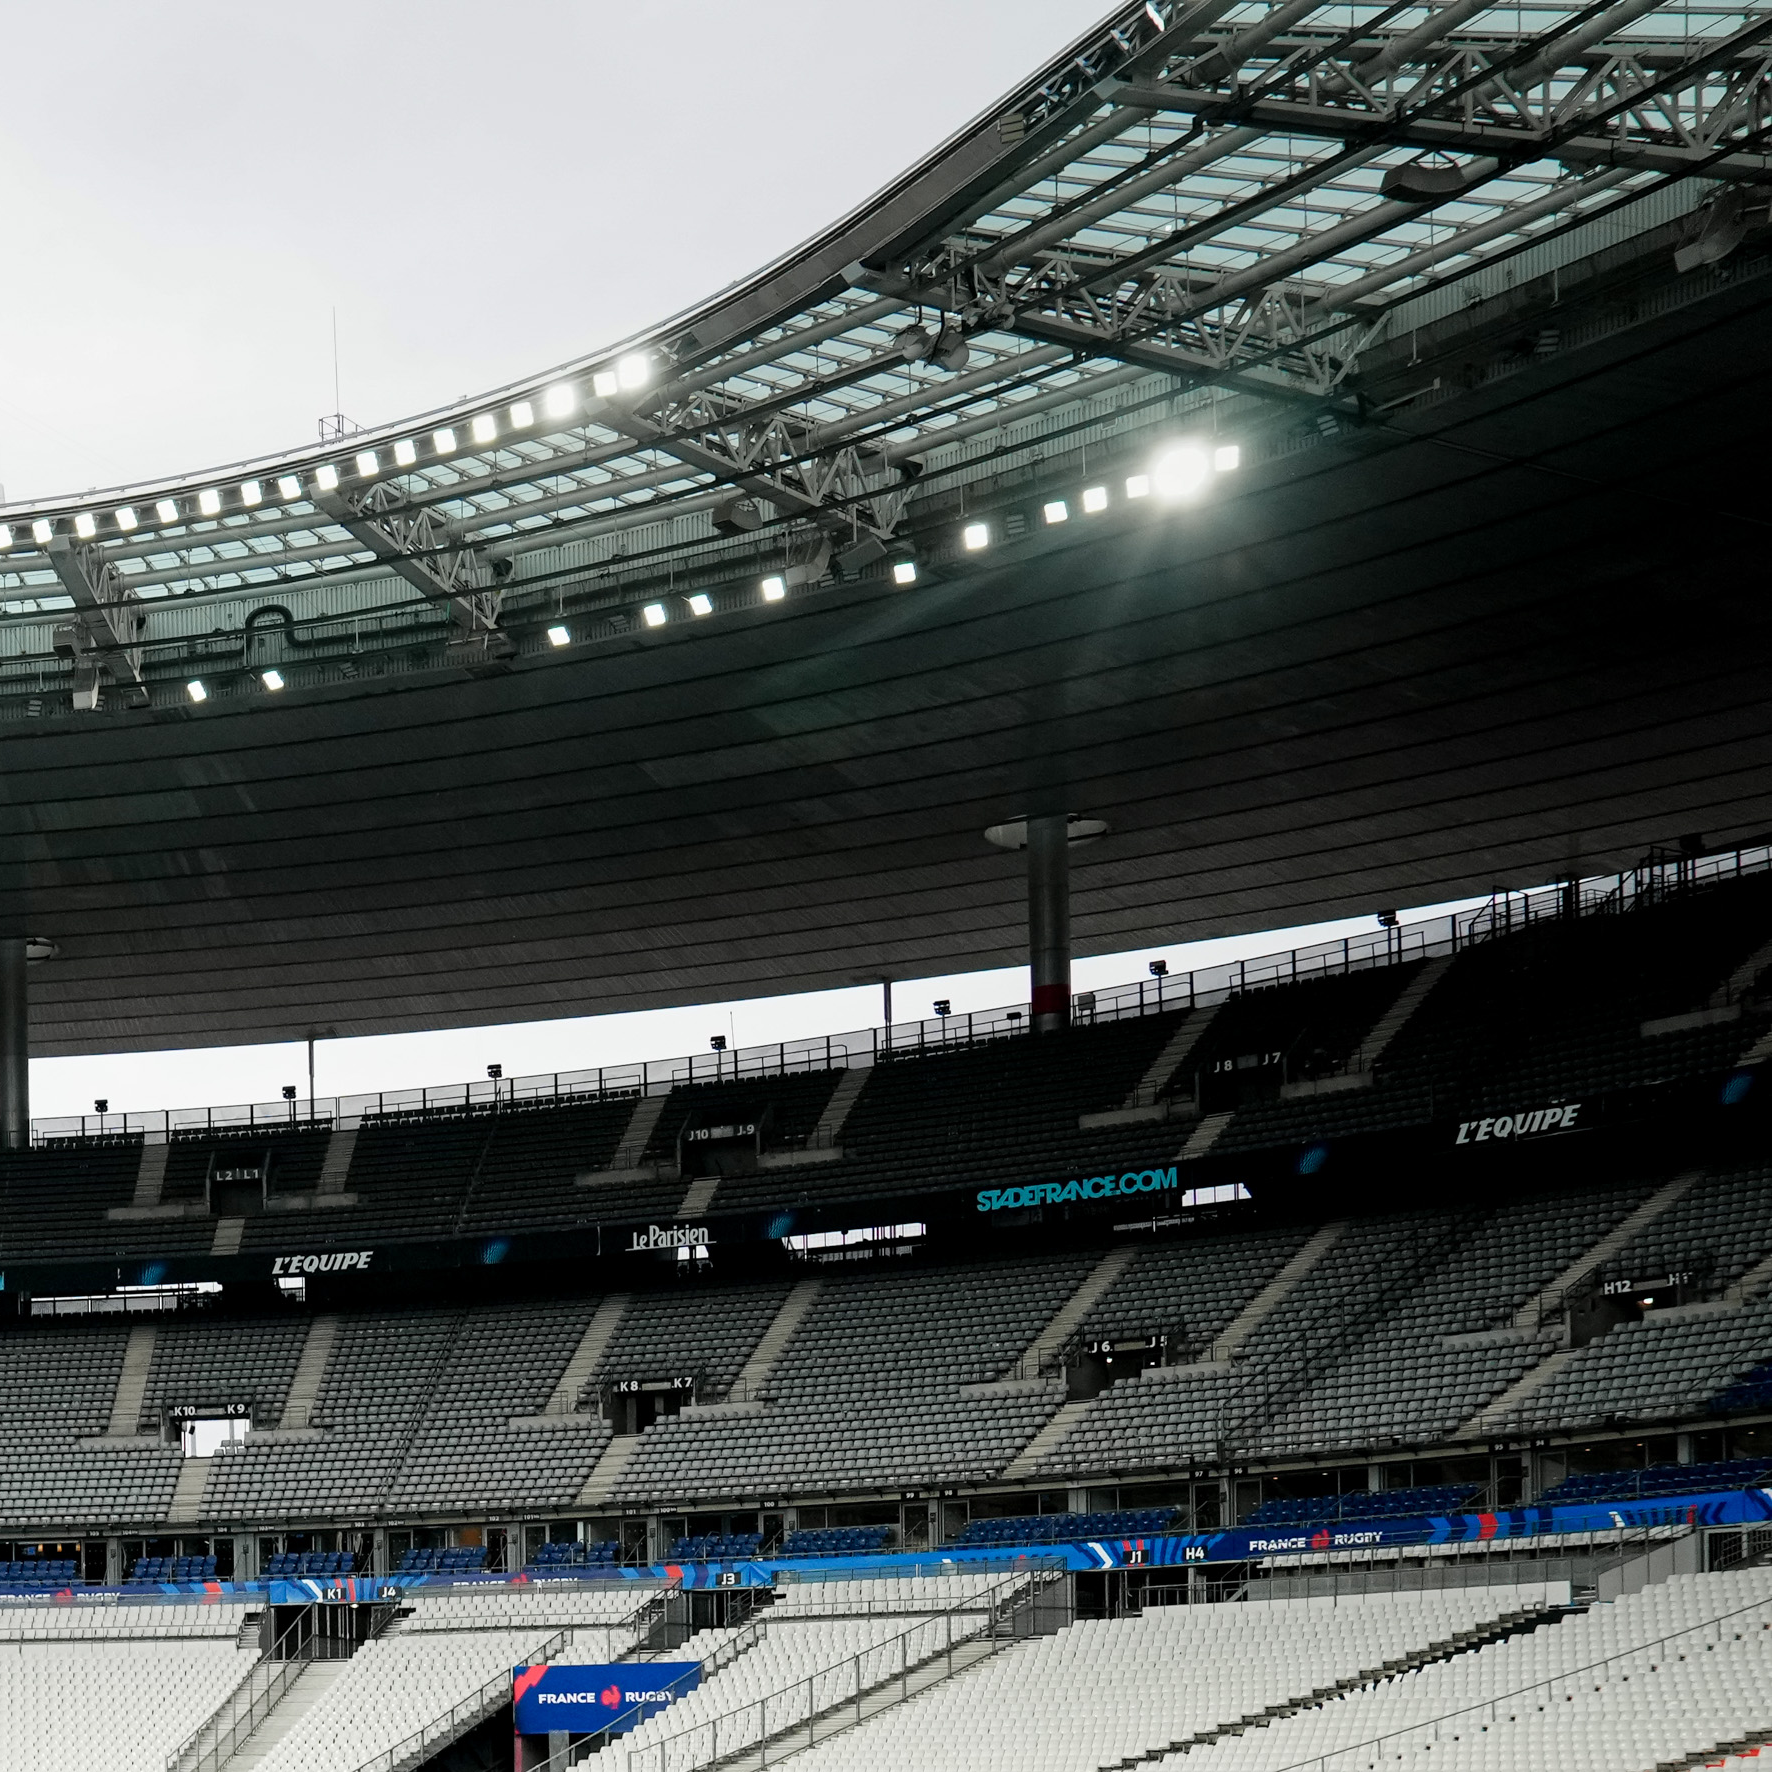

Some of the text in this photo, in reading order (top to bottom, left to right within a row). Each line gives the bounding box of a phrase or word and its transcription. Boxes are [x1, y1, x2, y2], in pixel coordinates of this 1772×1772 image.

[977, 1166, 1177, 1213] STADEFRANCE.COM
[633, 1225, 708, 1250] Le Parisien
[539, 1693, 595, 1704] FRANCE
